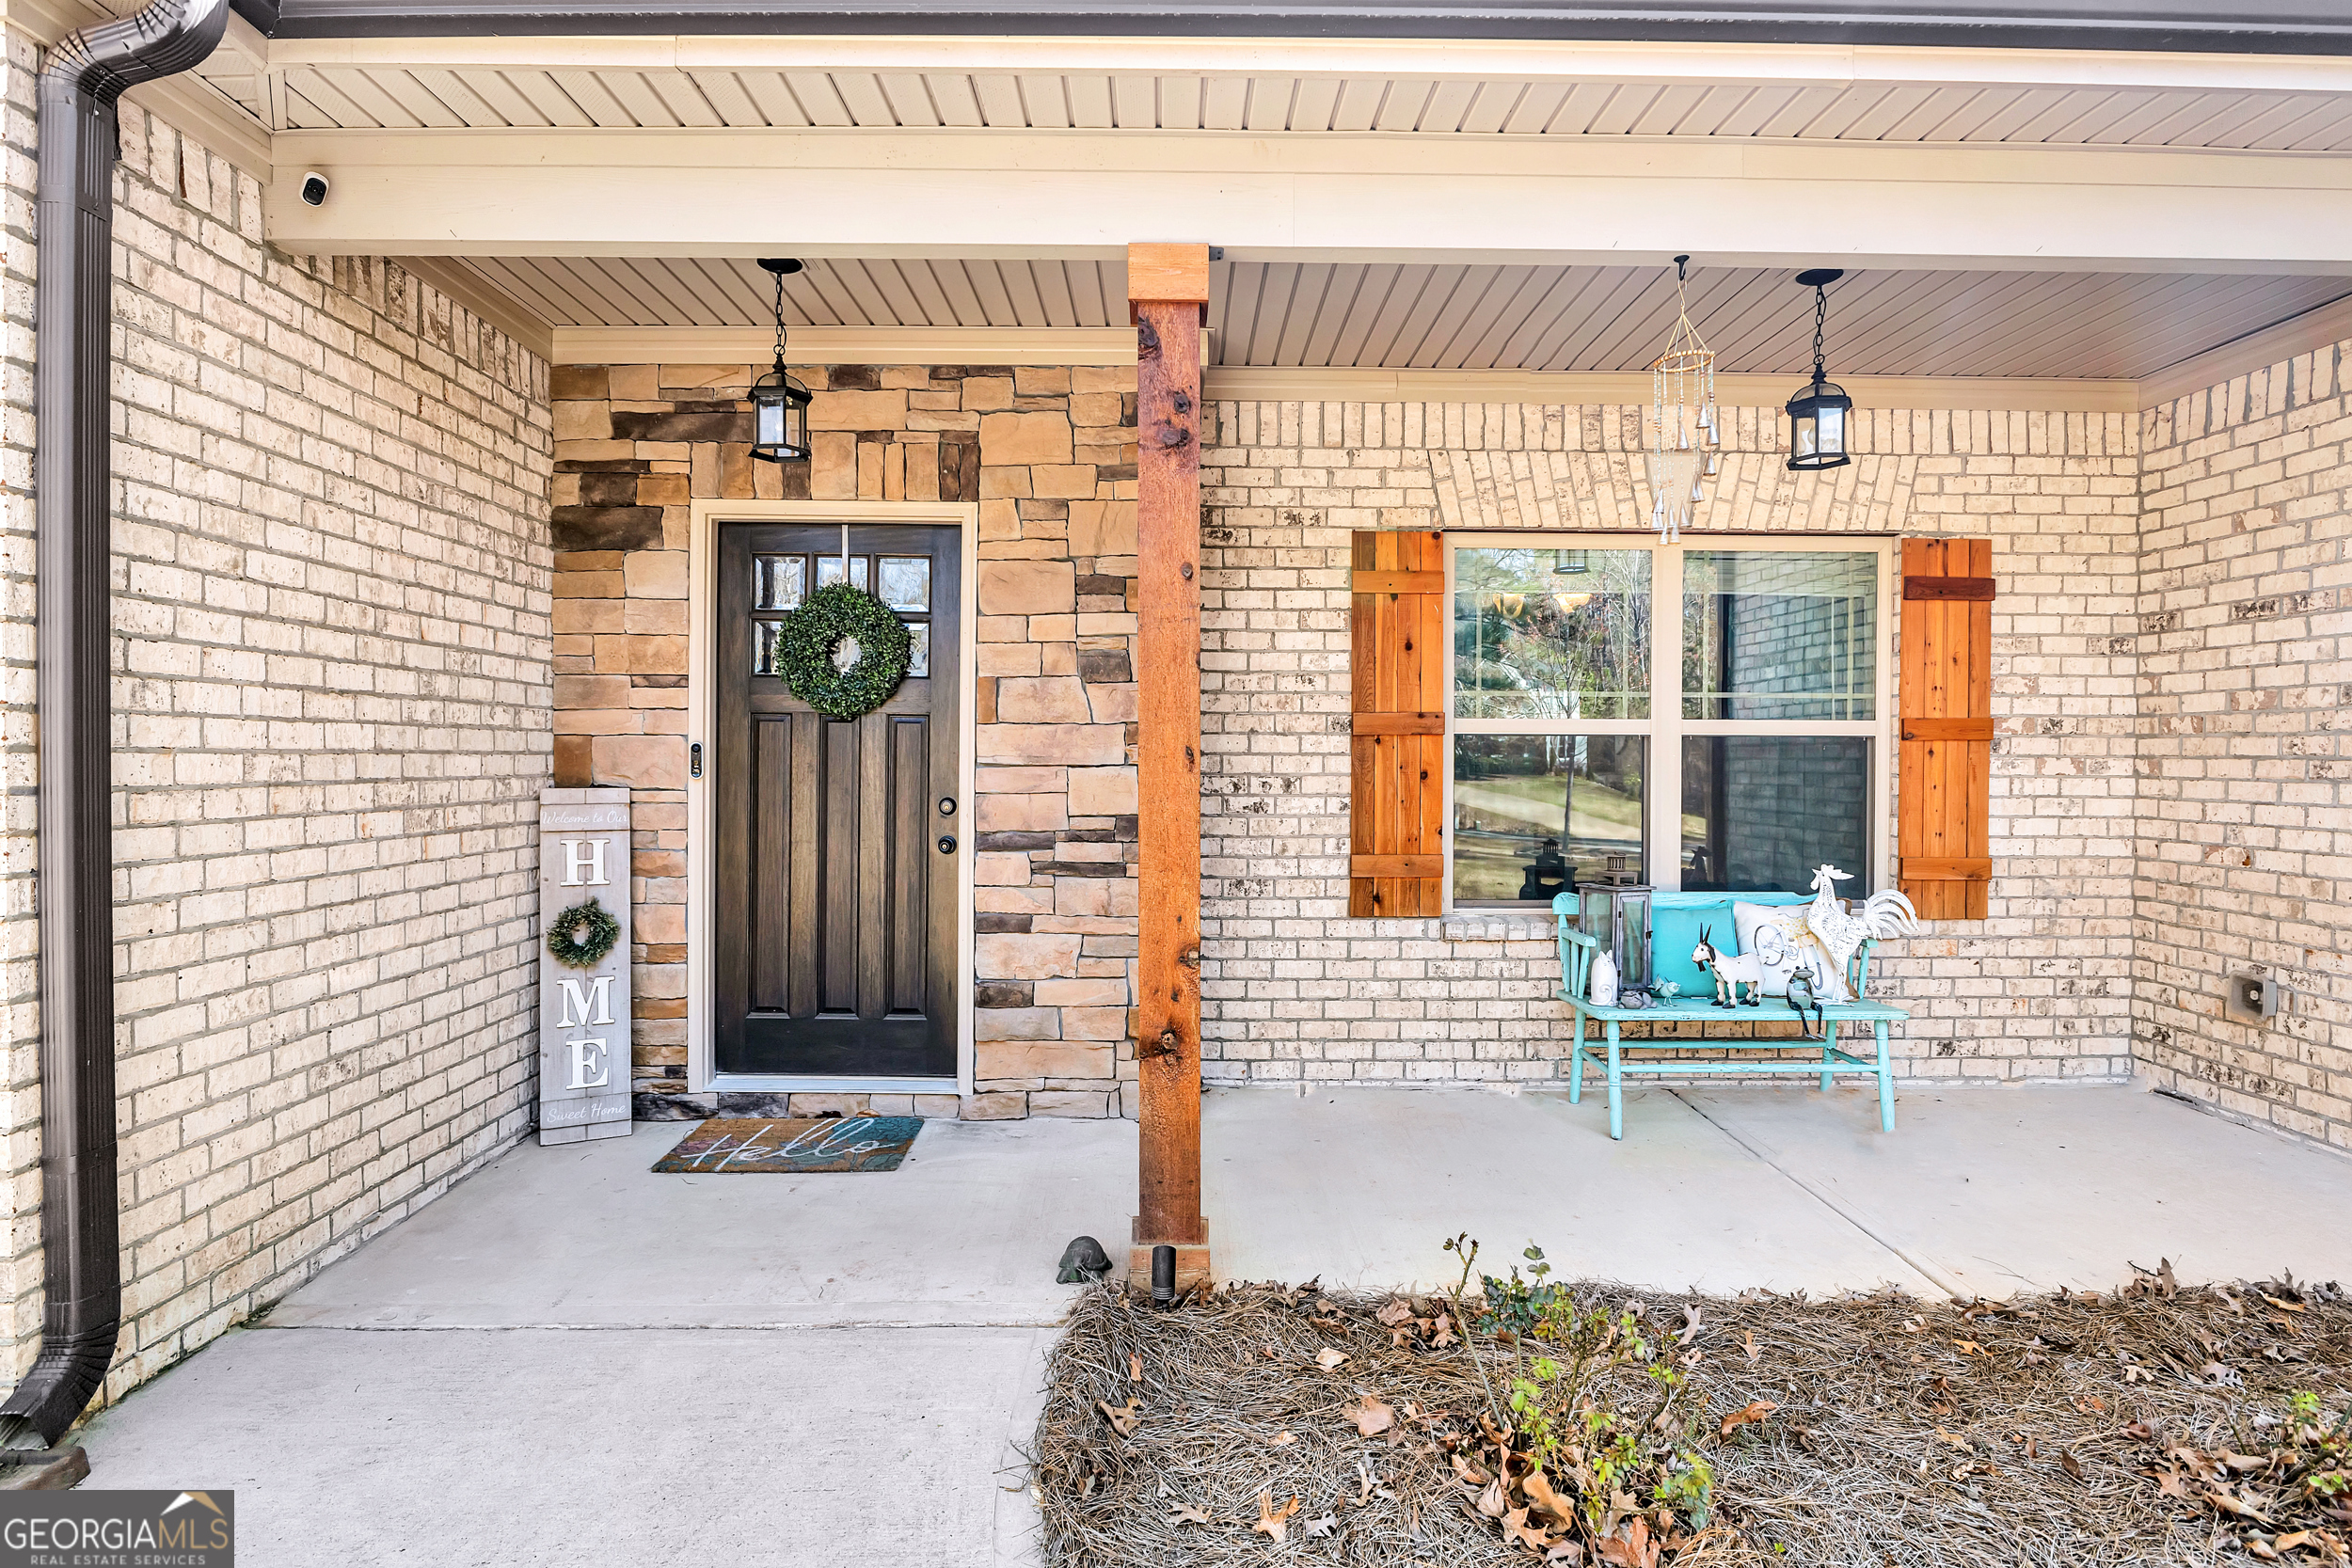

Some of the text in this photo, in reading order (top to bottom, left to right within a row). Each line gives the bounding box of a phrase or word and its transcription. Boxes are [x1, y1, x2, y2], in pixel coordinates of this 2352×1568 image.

[542, 810, 628, 824] Welcome to Our
[547, 1102, 627, 1123] Sweet Home
[681, 1117, 896, 1172] Hello
